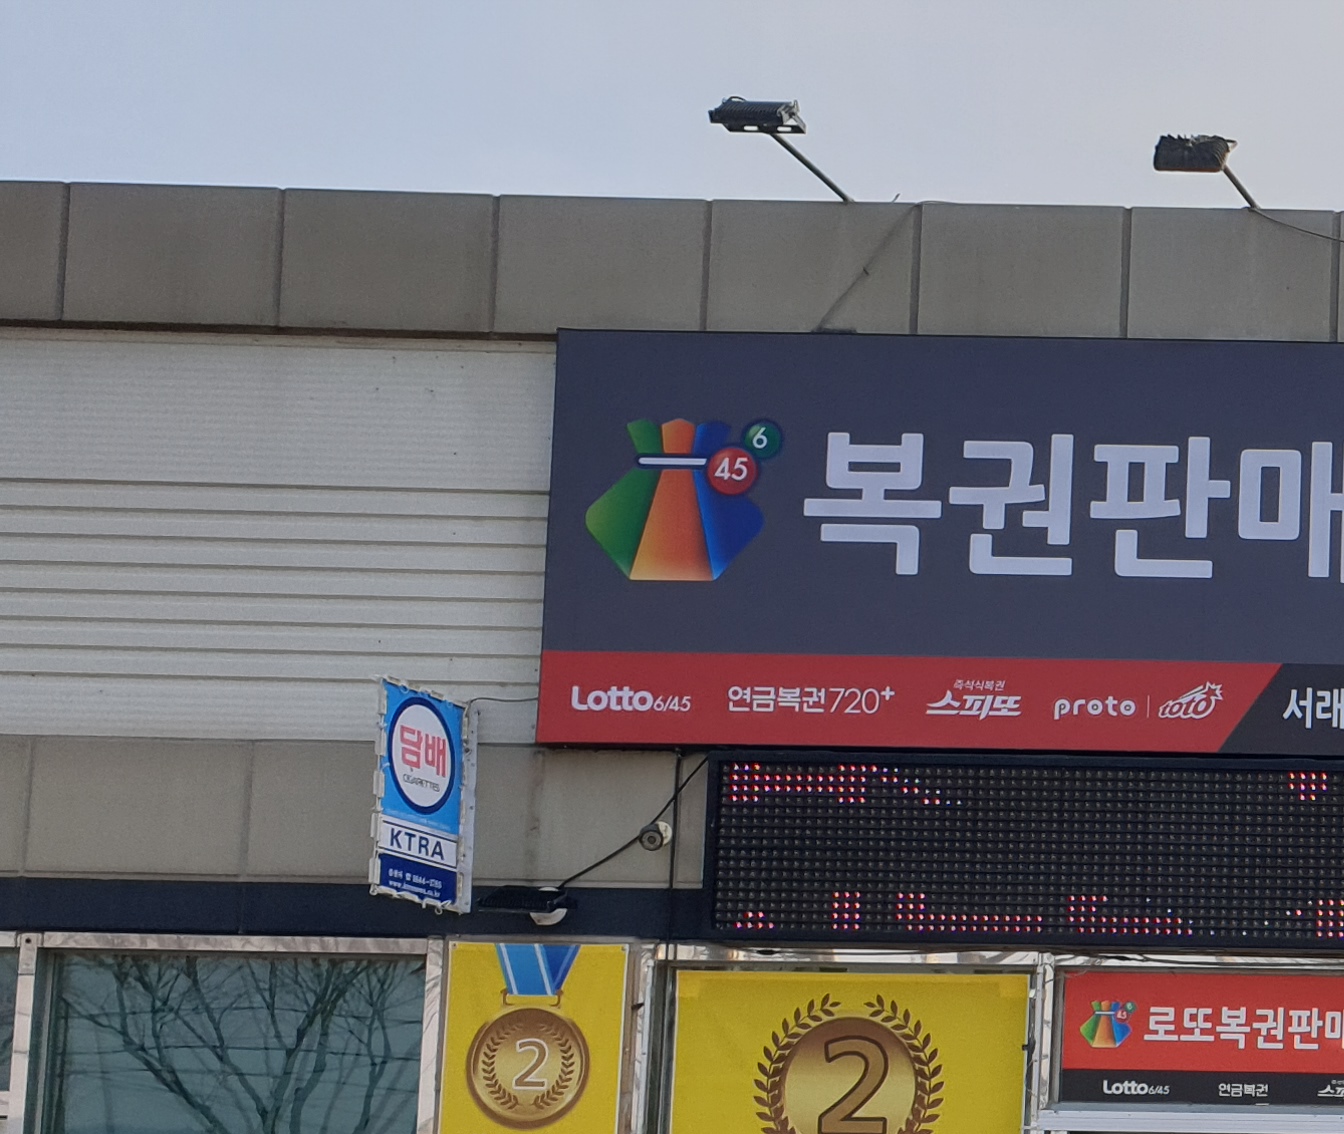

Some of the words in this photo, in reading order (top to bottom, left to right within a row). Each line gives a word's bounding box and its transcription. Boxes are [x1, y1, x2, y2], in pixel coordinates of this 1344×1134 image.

[925, 690, 1023, 721] 스피또
[1054, 695, 1137, 721] proto
[400, 724, 447, 778] 담배
[390, 827, 445, 861] KTRA
[1218, 1082, 1269, 1098] 연금복권
